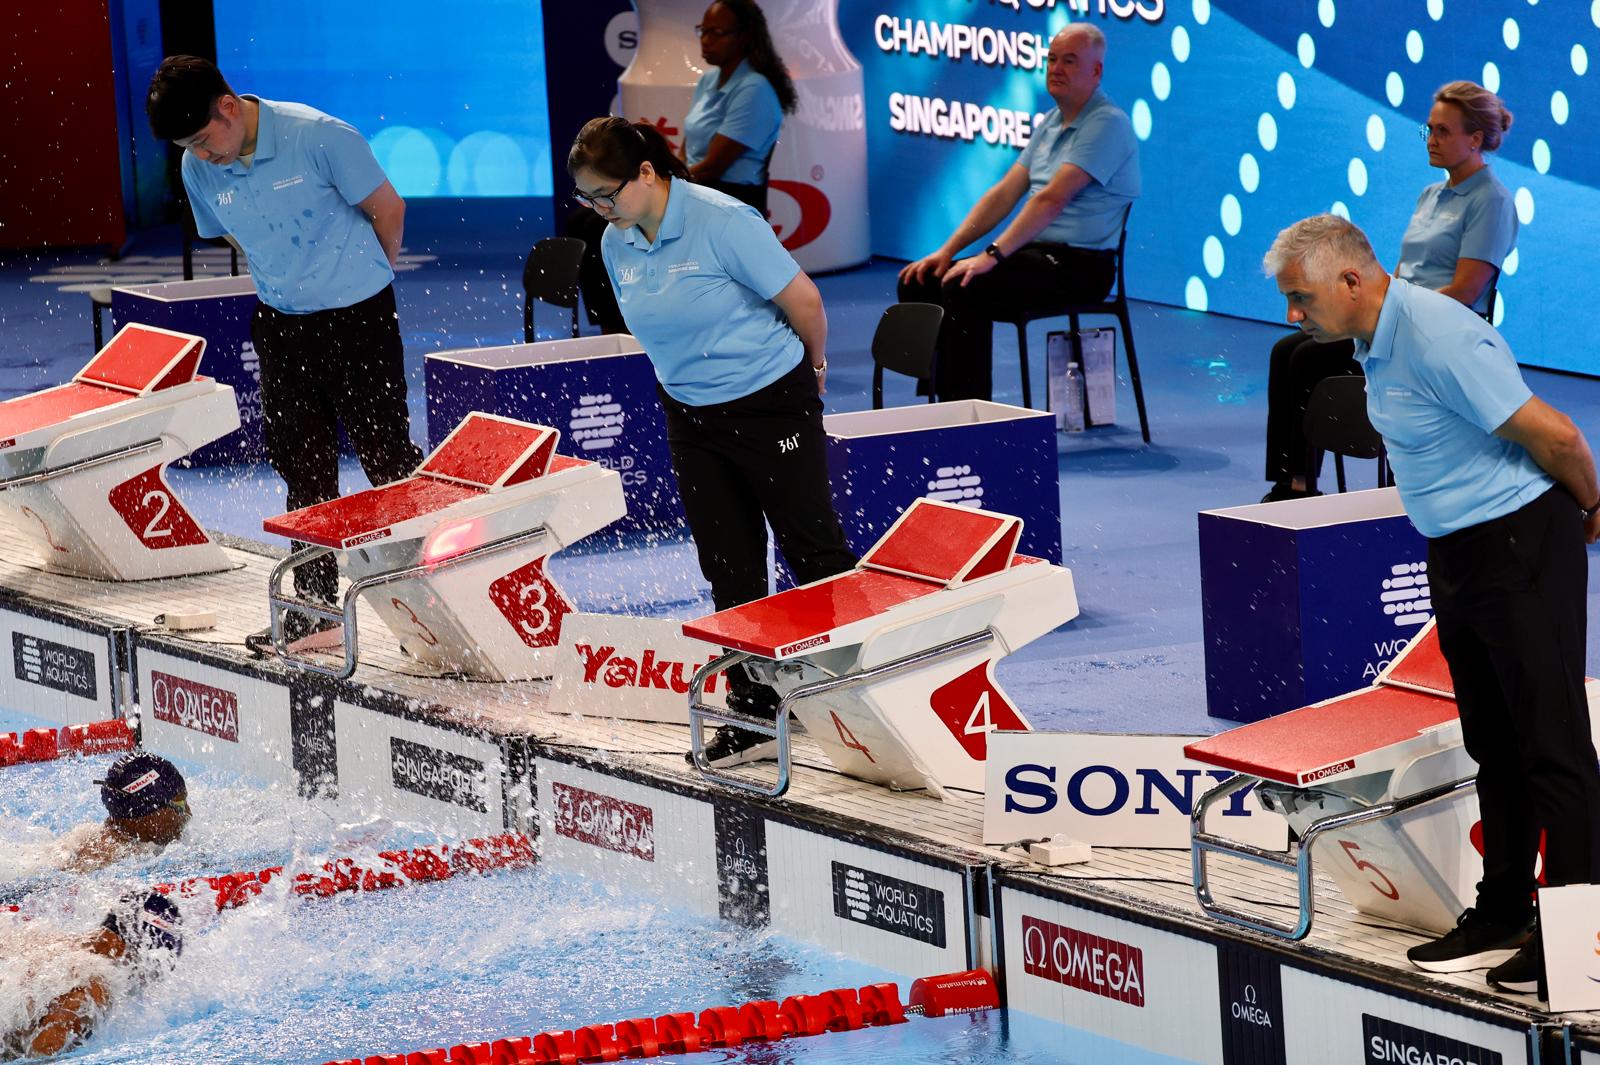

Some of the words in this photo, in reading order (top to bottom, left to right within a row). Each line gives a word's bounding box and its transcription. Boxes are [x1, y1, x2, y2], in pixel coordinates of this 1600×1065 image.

[874, 14, 1051, 70] CHAMPIONSH
[889, 92, 1031, 148] SINGAPORE
[597, 456, 634, 470] RLD
[142, 490, 172, 538] 2
[391, 598, 438, 645] 3
[520, 583, 551, 635] 3
[44, 649, 77, 669] WORLD
[796, 637, 825, 651] OMEGA
[46, 666, 88, 690] AQUATICS
[575, 644, 731, 694] Yakul
[174, 687, 238, 735] OMEGA
[963, 690, 998, 736] 4
[829, 710, 876, 763] 4
[1004, 763, 1260, 817] SONY
[1318, 763, 1350, 778] OMEGA
[1338, 840, 1399, 900] 5
[874, 883, 918, 909] WORLD
[876, 904, 934, 934] AQUATICS
[1052, 937, 1143, 998] OMEGA
[1232, 1002, 1272, 1028] OMEGA
[1371, 1035, 1479, 1065] SINGAP
